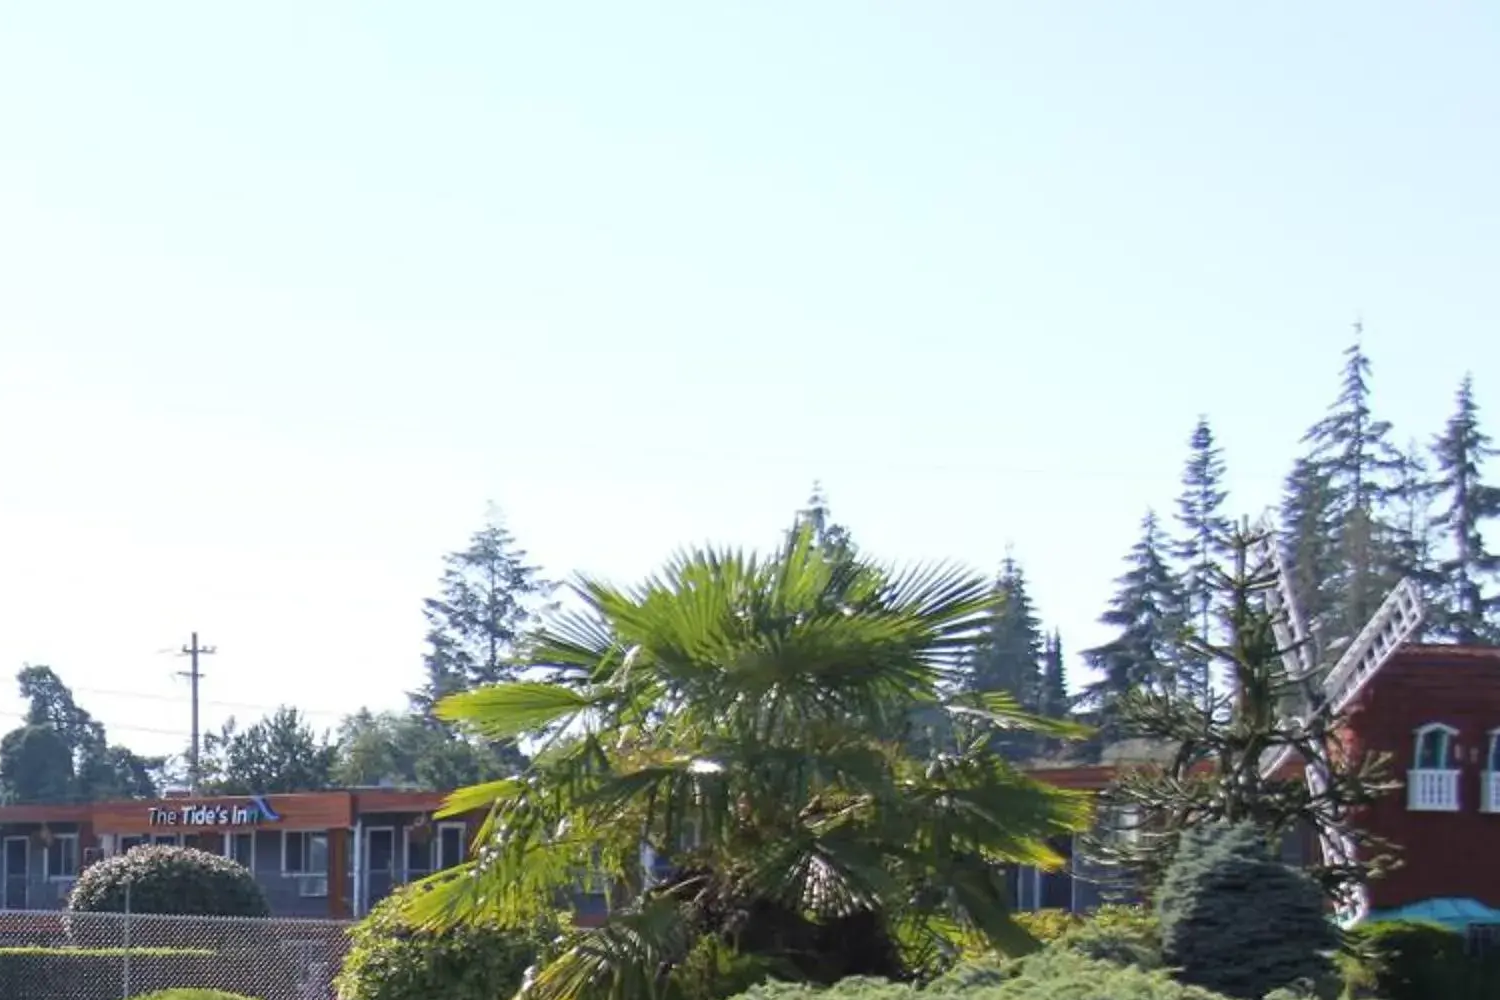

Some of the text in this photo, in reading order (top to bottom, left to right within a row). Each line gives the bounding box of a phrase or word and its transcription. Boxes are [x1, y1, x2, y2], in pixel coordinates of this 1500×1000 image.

[148, 804, 258, 826] The Tide's Inn
